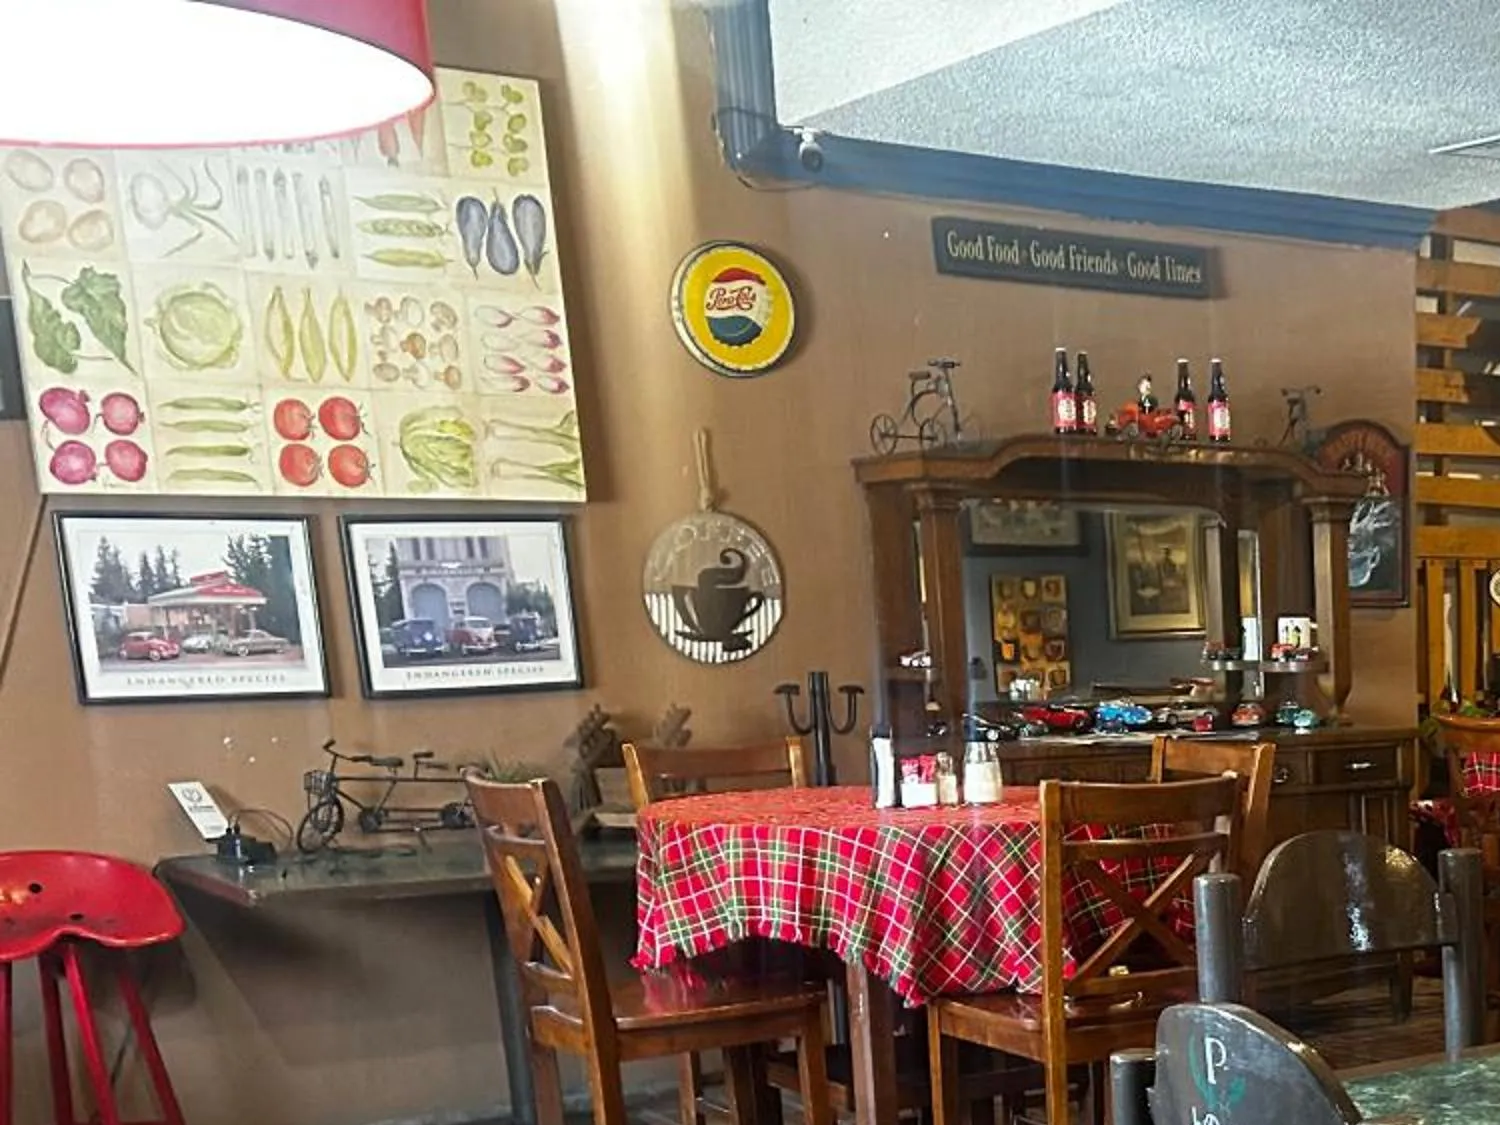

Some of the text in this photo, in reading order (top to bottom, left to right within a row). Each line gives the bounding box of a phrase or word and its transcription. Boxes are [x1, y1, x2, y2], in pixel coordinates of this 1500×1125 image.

[946, 230, 1201, 283] Good Food Good Friends Good Times
